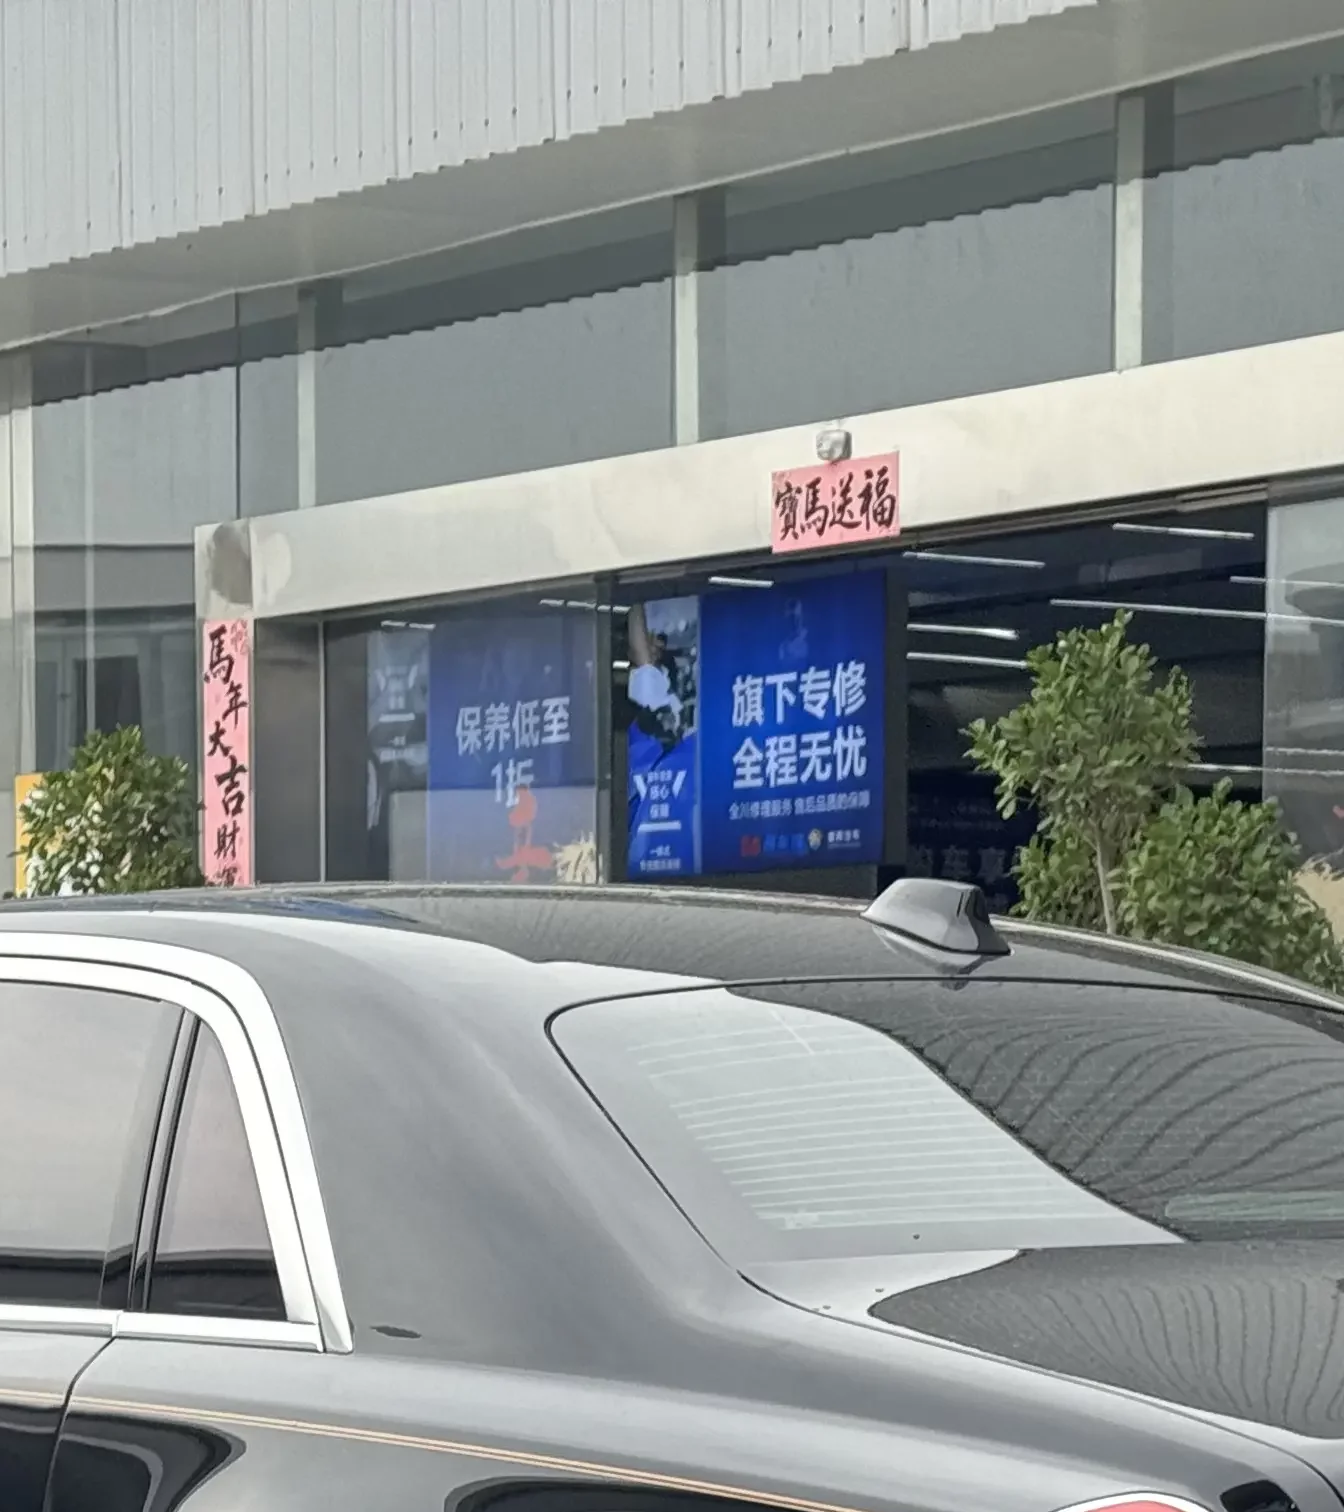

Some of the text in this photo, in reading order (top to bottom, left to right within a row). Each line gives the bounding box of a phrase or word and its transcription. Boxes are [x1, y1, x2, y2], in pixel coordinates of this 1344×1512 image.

[774, 465, 896, 541] 寶馬送福
[455, 696, 571, 757] 保养低至
[731, 660, 867, 728] 旗下专修
[491, 758, 535, 808] 1折
[732, 724, 868, 789] 全程无忧
